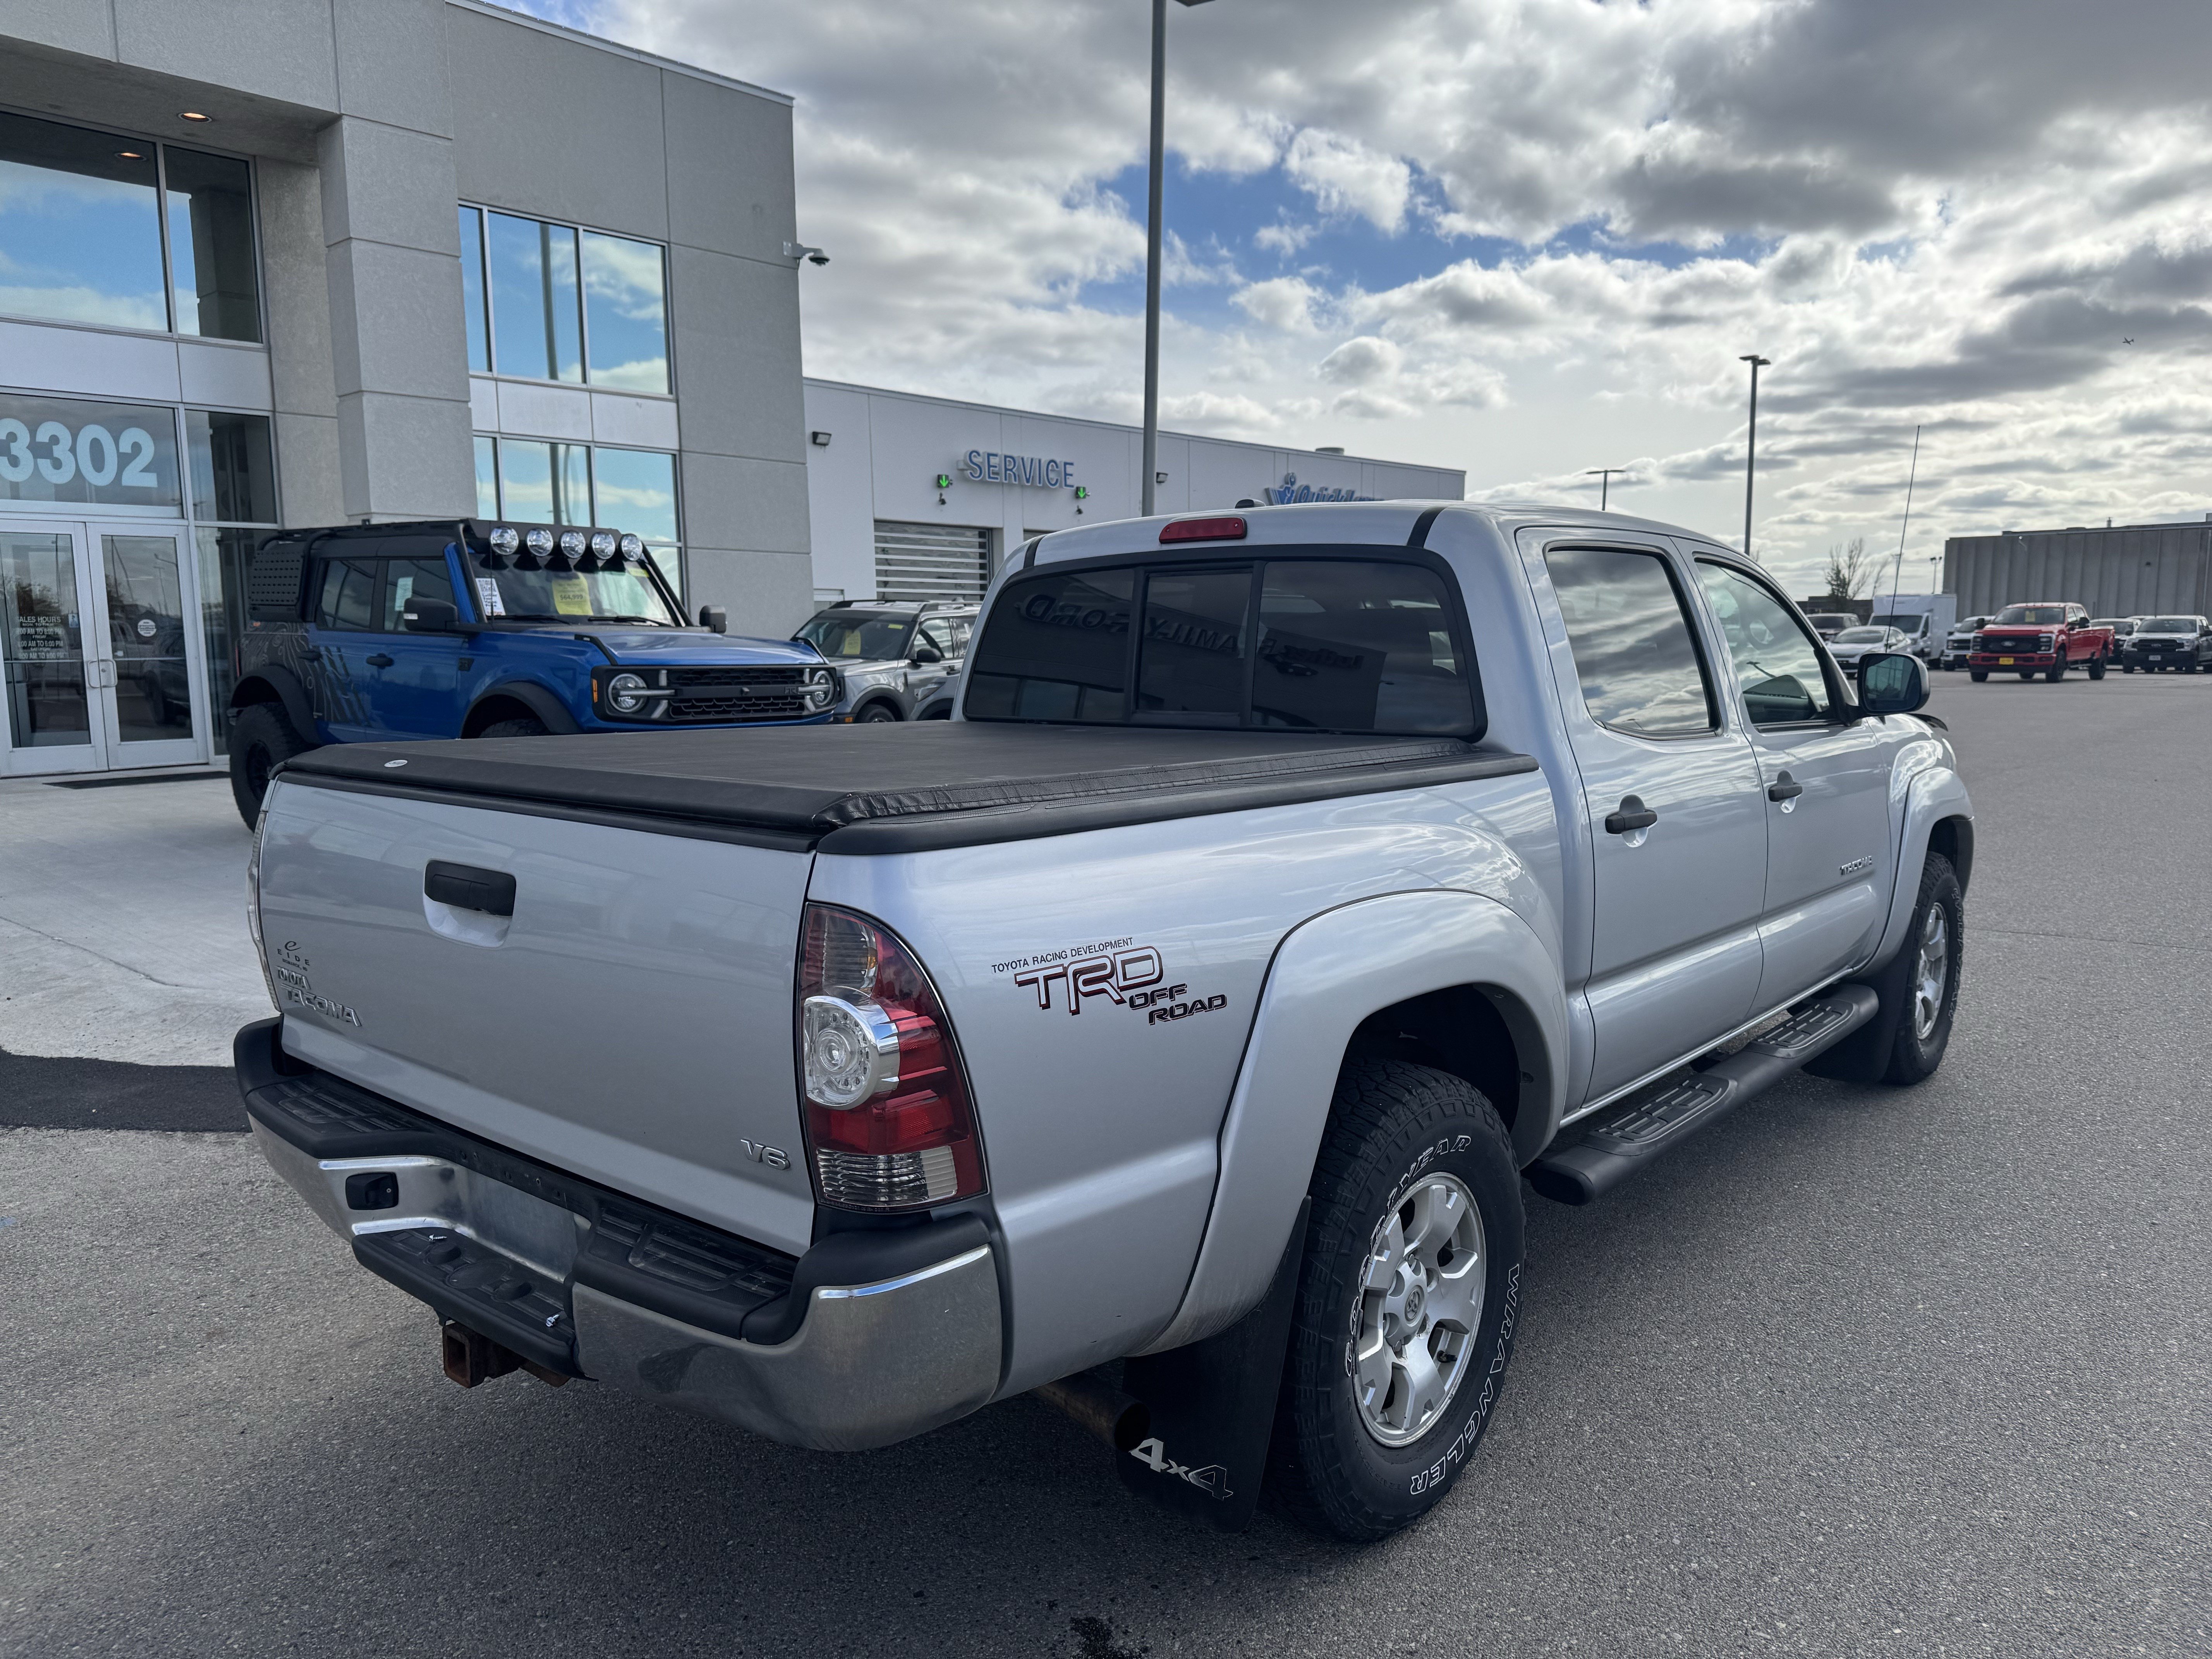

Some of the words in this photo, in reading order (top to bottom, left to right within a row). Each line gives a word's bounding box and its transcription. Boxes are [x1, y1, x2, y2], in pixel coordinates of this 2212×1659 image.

[0, 418, 158, 488] 3302
[967, 450, 1075, 489] SERVICE
[277, 948, 310, 966] EIDE
[991, 958, 1029, 974] TOYOTA
[1032, 950, 1068, 965] RACING
[1070, 937, 1133, 957] DEVELOPMENT
[275, 966, 311, 990] TOYOTA
[1014, 945, 1163, 1016] TRD
[1128, 983, 1188, 1010] OFF
[280, 983, 362, 1027] TACOMA
[1148, 994, 1227, 1025] ROAD
[740, 1139, 790, 1170] V6
[1410, 1263, 1520, 1496] WRANGLER
[1128, 1437, 1233, 1501] 4x4
